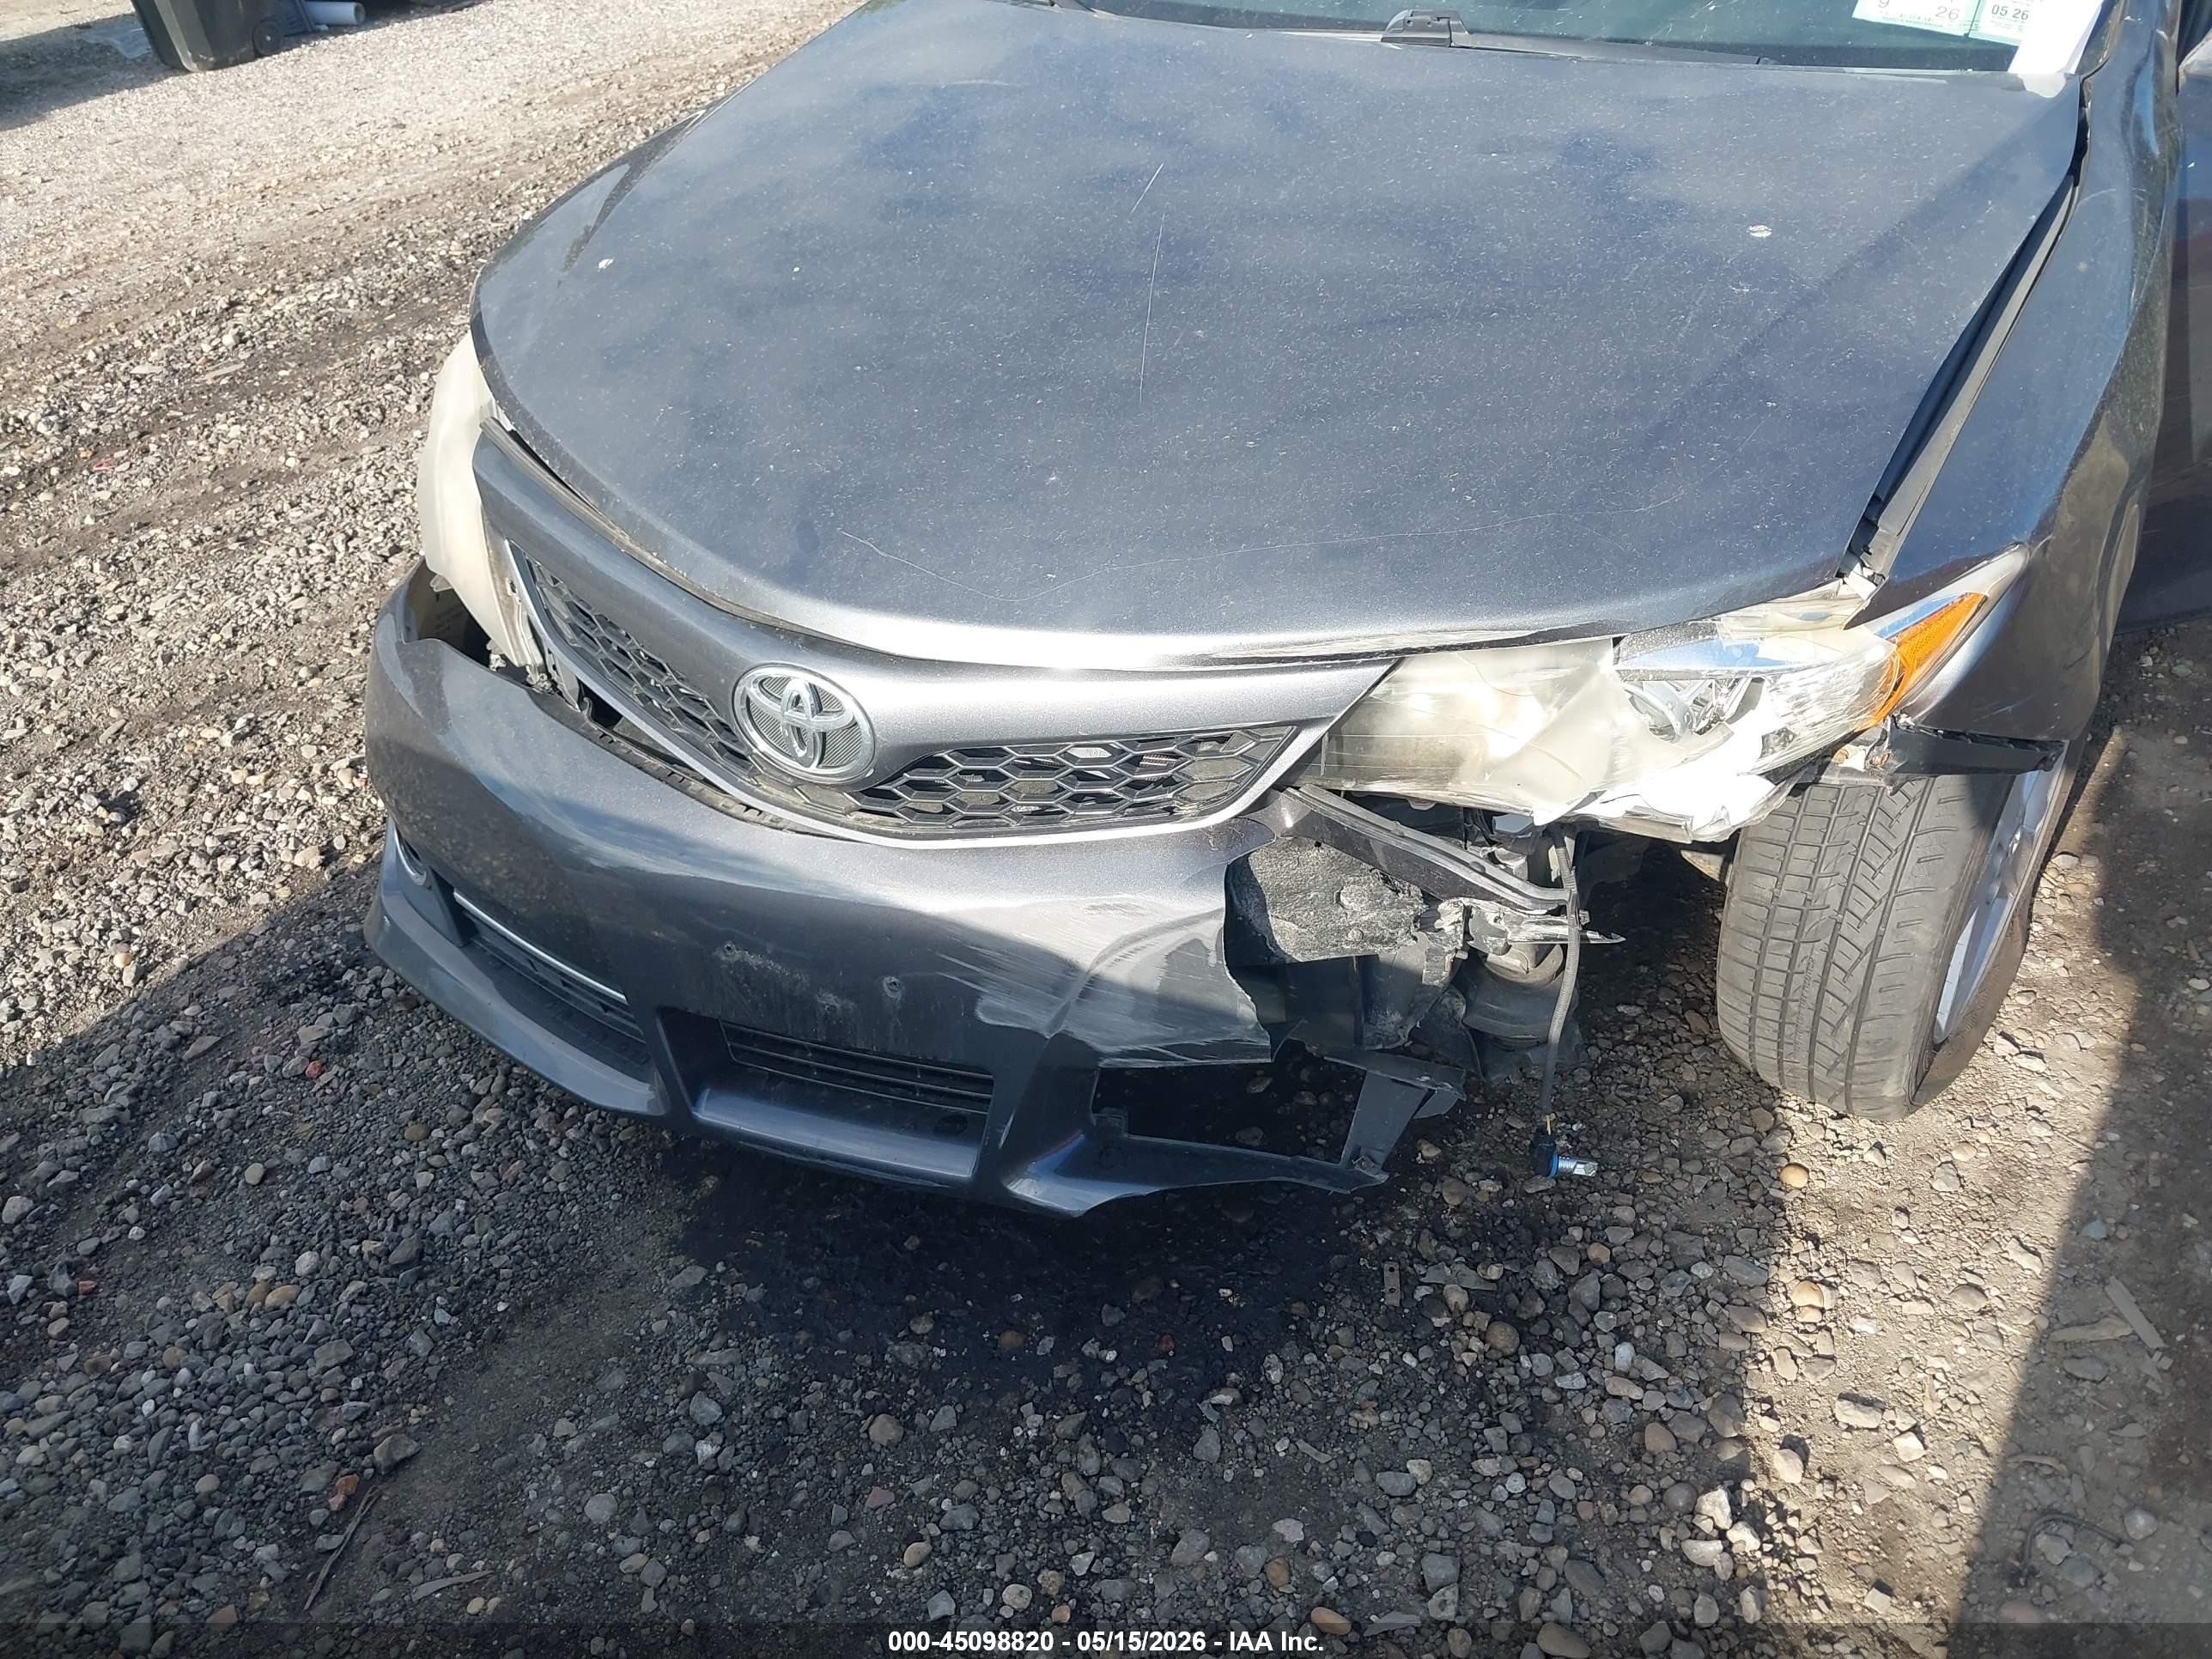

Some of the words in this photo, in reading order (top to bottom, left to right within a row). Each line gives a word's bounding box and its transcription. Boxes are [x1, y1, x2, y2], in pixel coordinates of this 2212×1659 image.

[1935, 6, 1960, 20] 26
[1991, 4, 2008, 16] 05
[2012, 8, 2029, 20] 26
